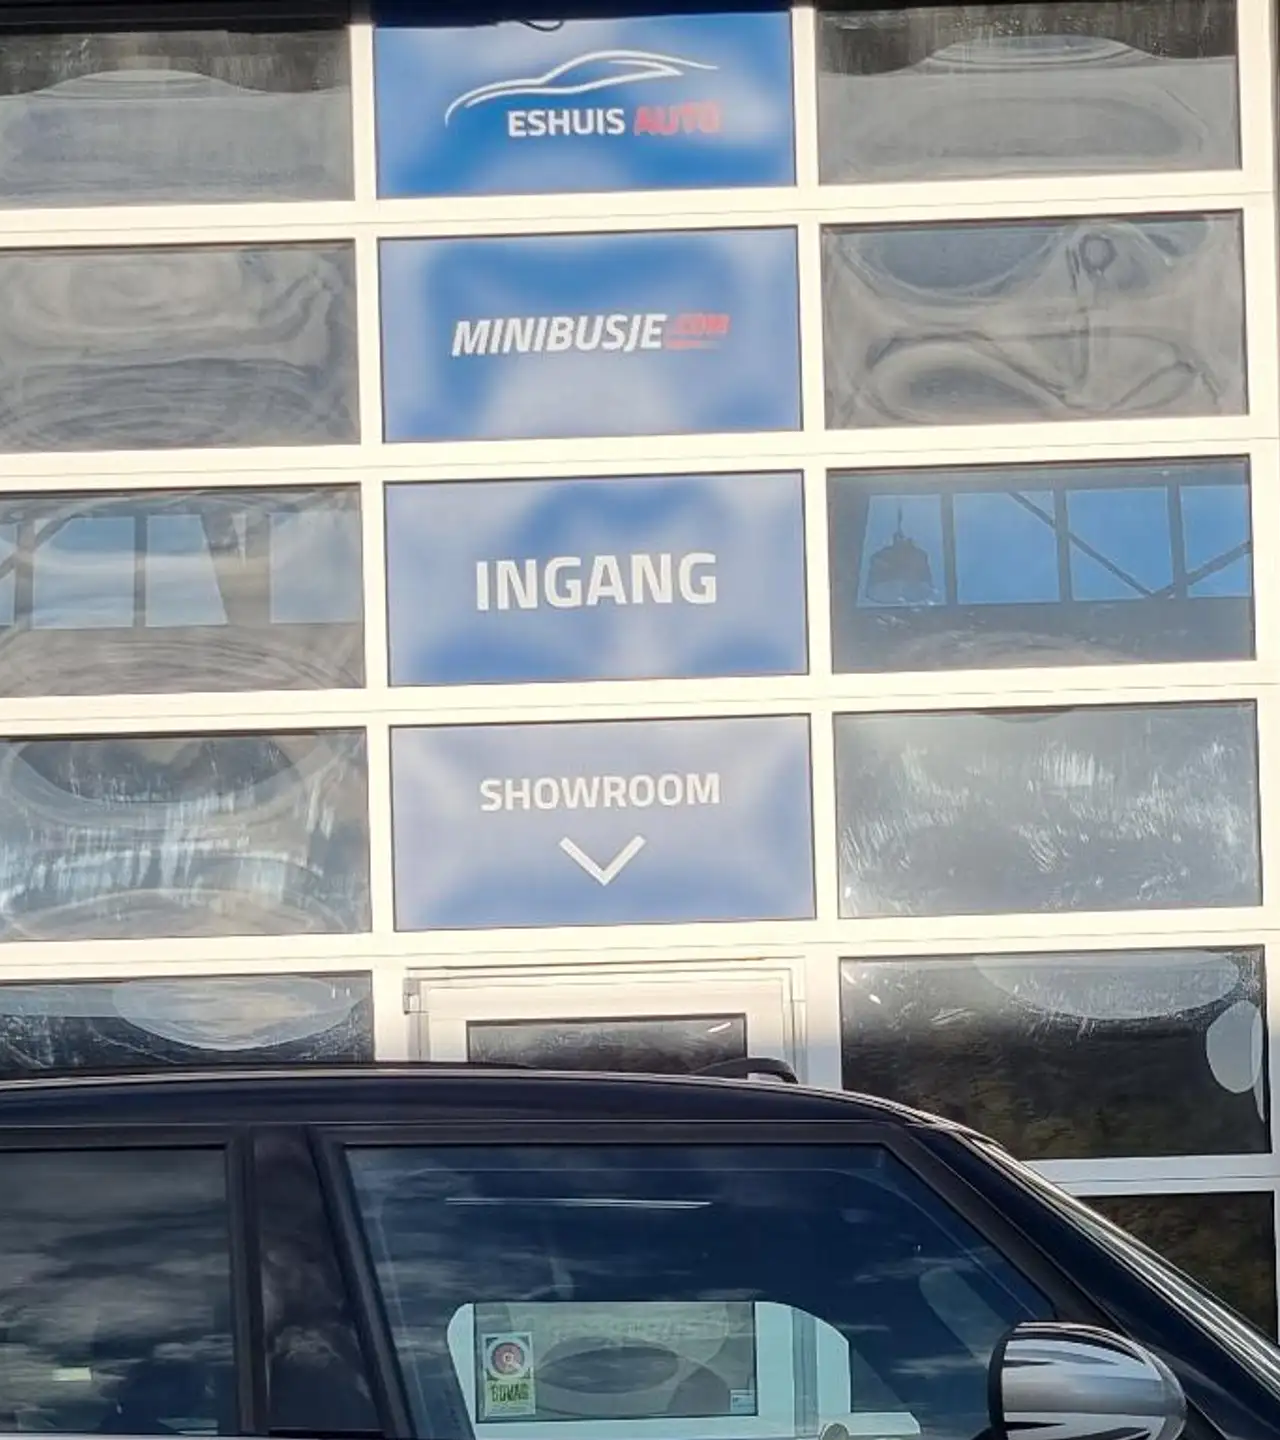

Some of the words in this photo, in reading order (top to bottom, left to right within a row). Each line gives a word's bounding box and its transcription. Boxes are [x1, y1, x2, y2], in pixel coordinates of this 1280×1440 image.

[507, 107, 626, 137] ESHUIS
[633, 104, 720, 135] AUTO
[475, 552, 717, 612] INGANG
[479, 772, 720, 812] SHOWROOM
